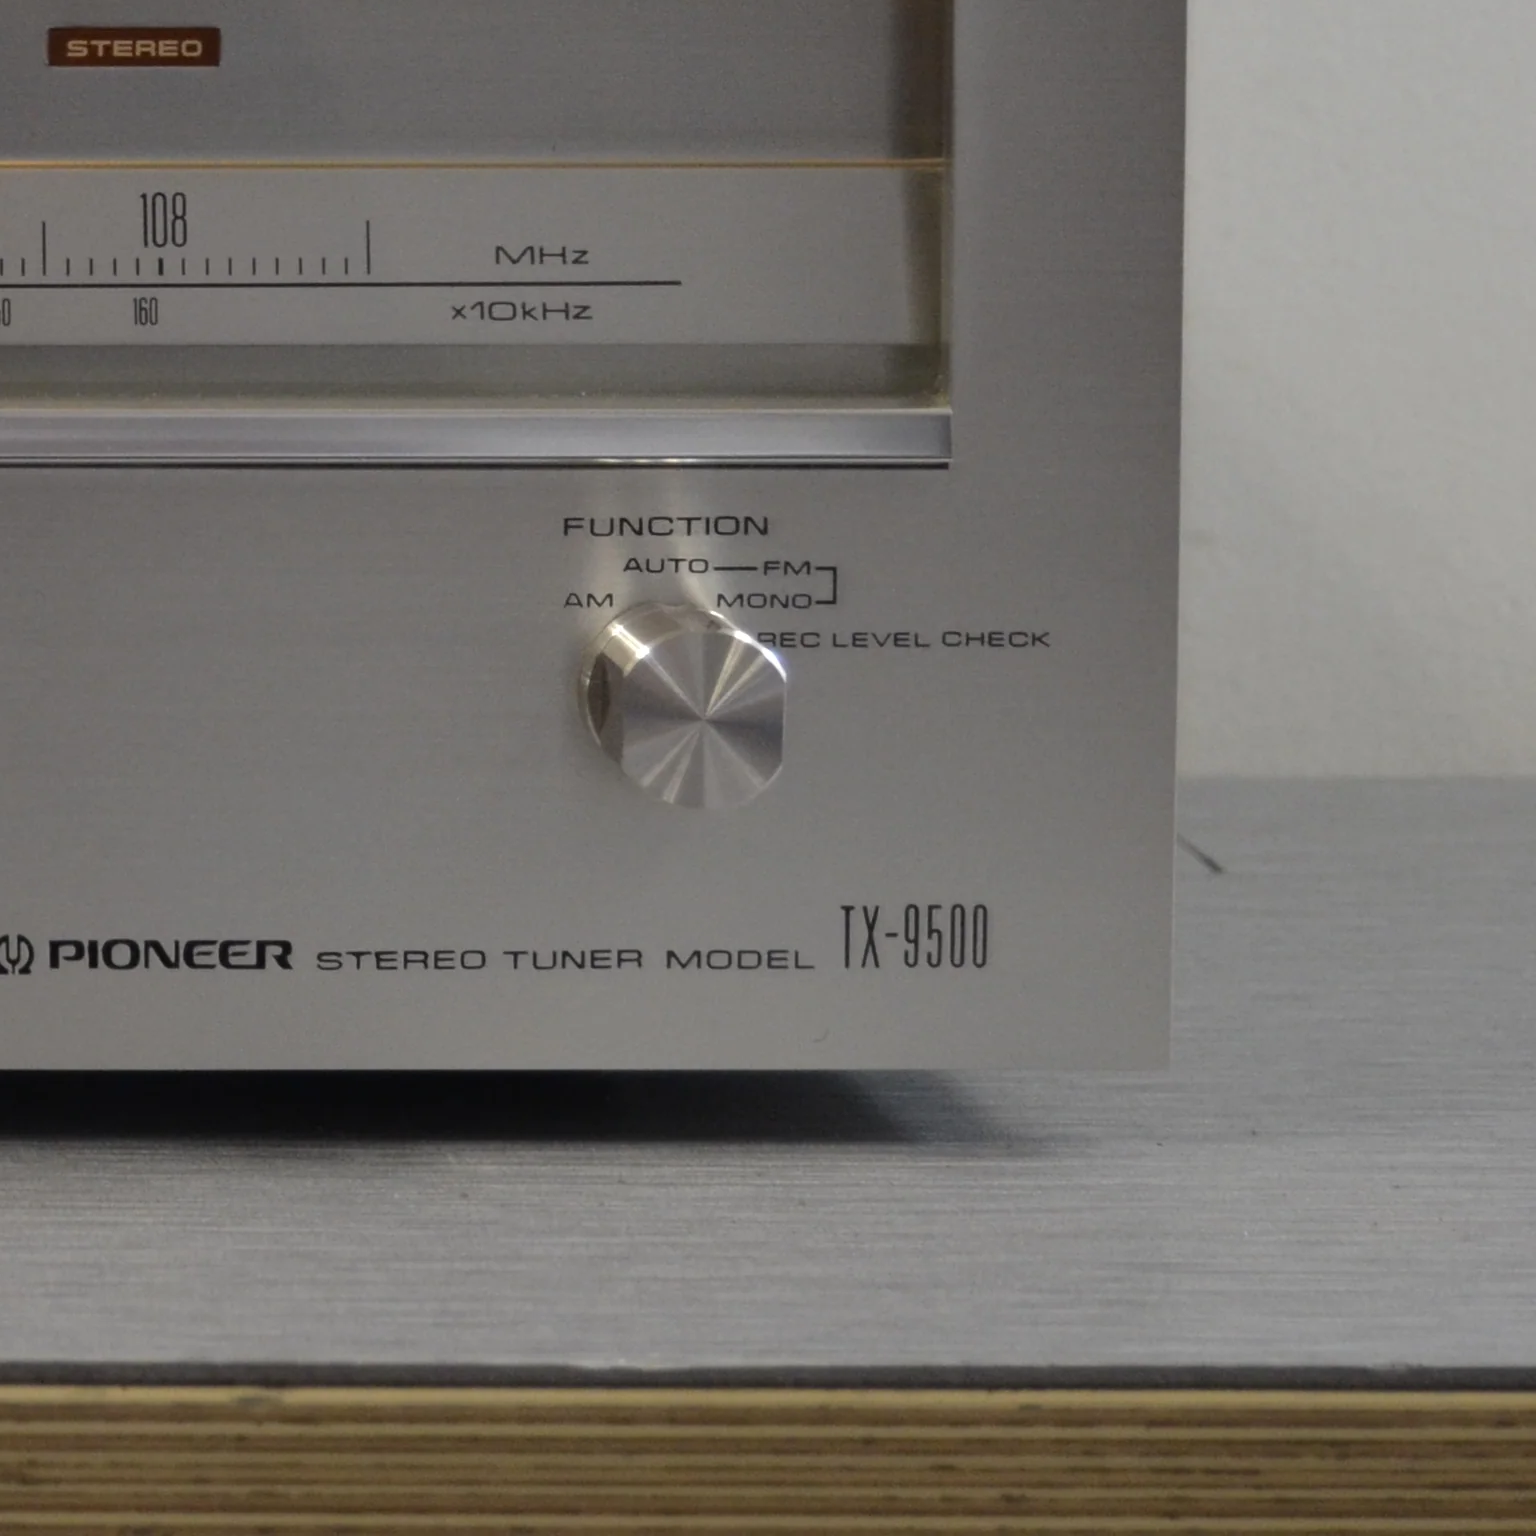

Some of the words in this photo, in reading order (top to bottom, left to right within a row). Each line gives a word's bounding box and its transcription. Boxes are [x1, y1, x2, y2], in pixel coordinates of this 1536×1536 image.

[66, 39, 203, 58] STEREO
[139, 191, 188, 249] 108
[495, 245, 589, 266] MHz
[132, 296, 159, 327] 160
[563, 515, 769, 537] FUNCTION
[623, 558, 709, 574] AUTO
[763, 560, 812, 576] FM
[562, 591, 614, 609] AM
[716, 593, 813, 609] MONO
[757, 631, 821, 649] REC
[832, 631, 931, 649] LEVEL
[941, 630, 1051, 648] CHECK
[48, 938, 293, 971] PIONEER
[316, 949, 487, 971] STEREO
[502, 949, 643, 971] TUNER
[666, 949, 815, 970] MODEL
[840, 903, 988, 969] TX-9500
